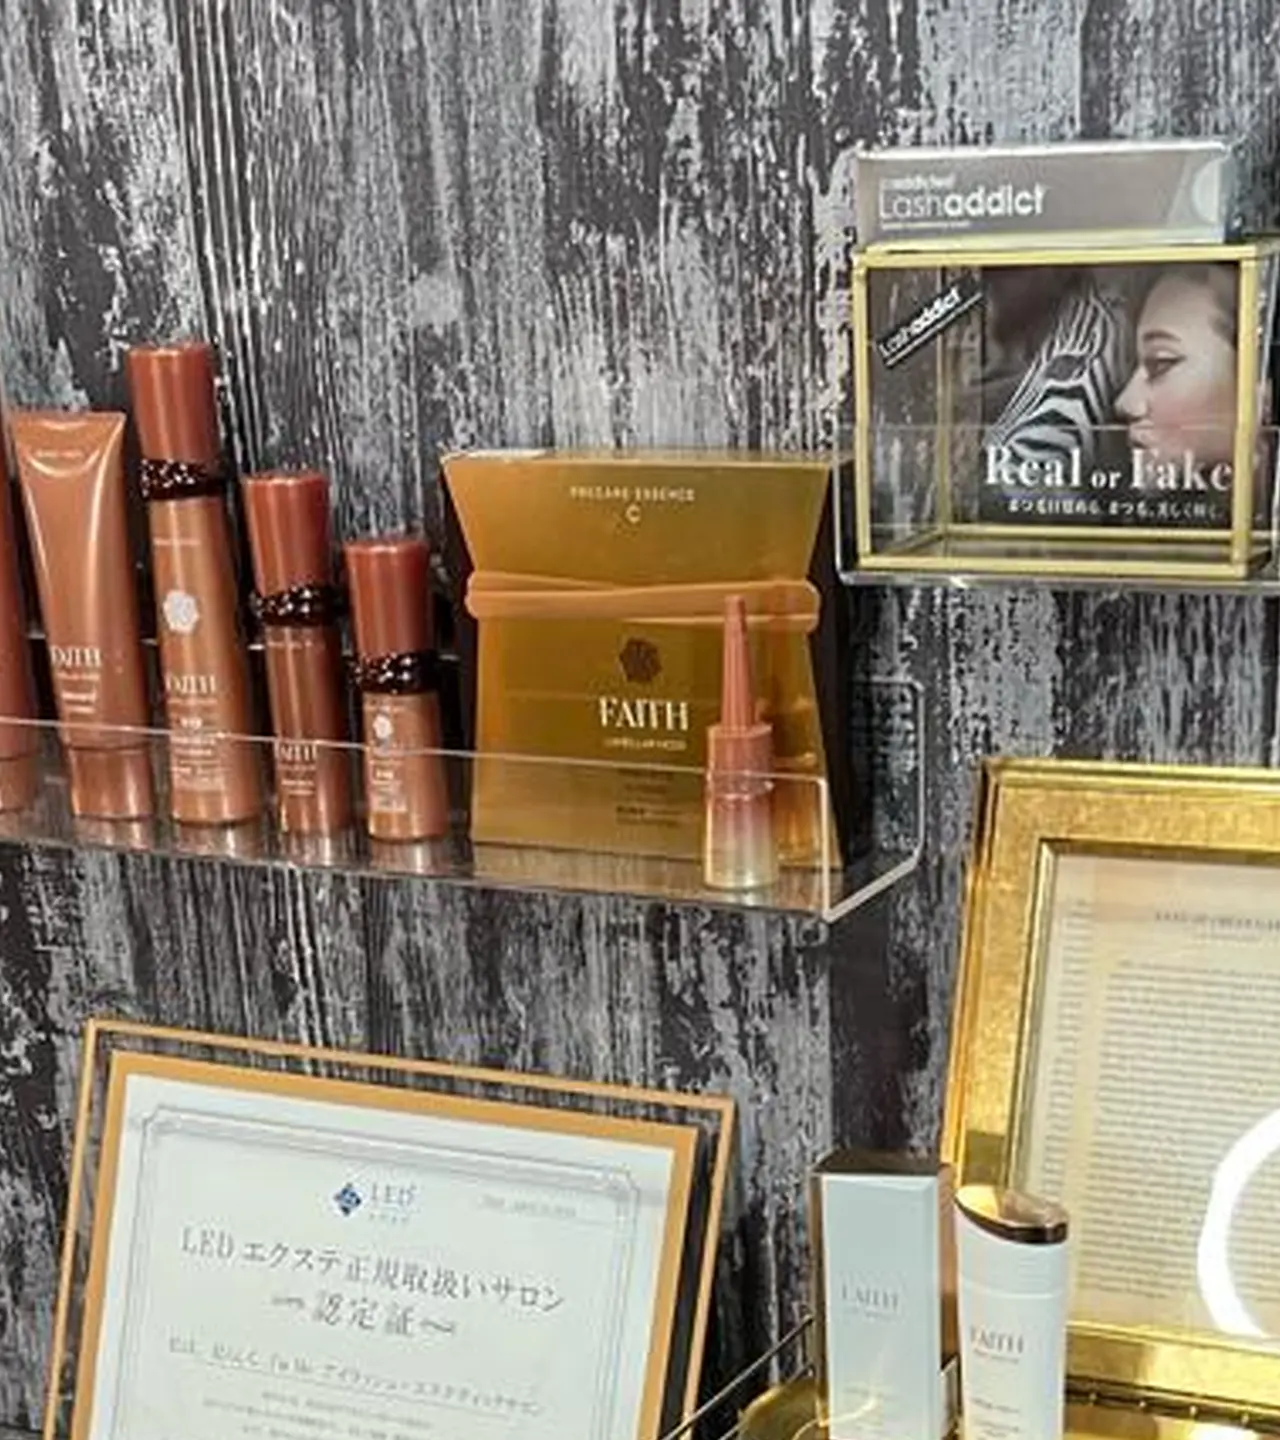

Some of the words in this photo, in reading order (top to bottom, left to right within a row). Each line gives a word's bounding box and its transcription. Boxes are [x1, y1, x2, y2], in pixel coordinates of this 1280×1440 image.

[984, 443, 1081, 489] Real
[1090, 467, 1121, 490] or
[1130, 447, 1233, 492] Fake
[599, 696, 689, 731] FAITH
